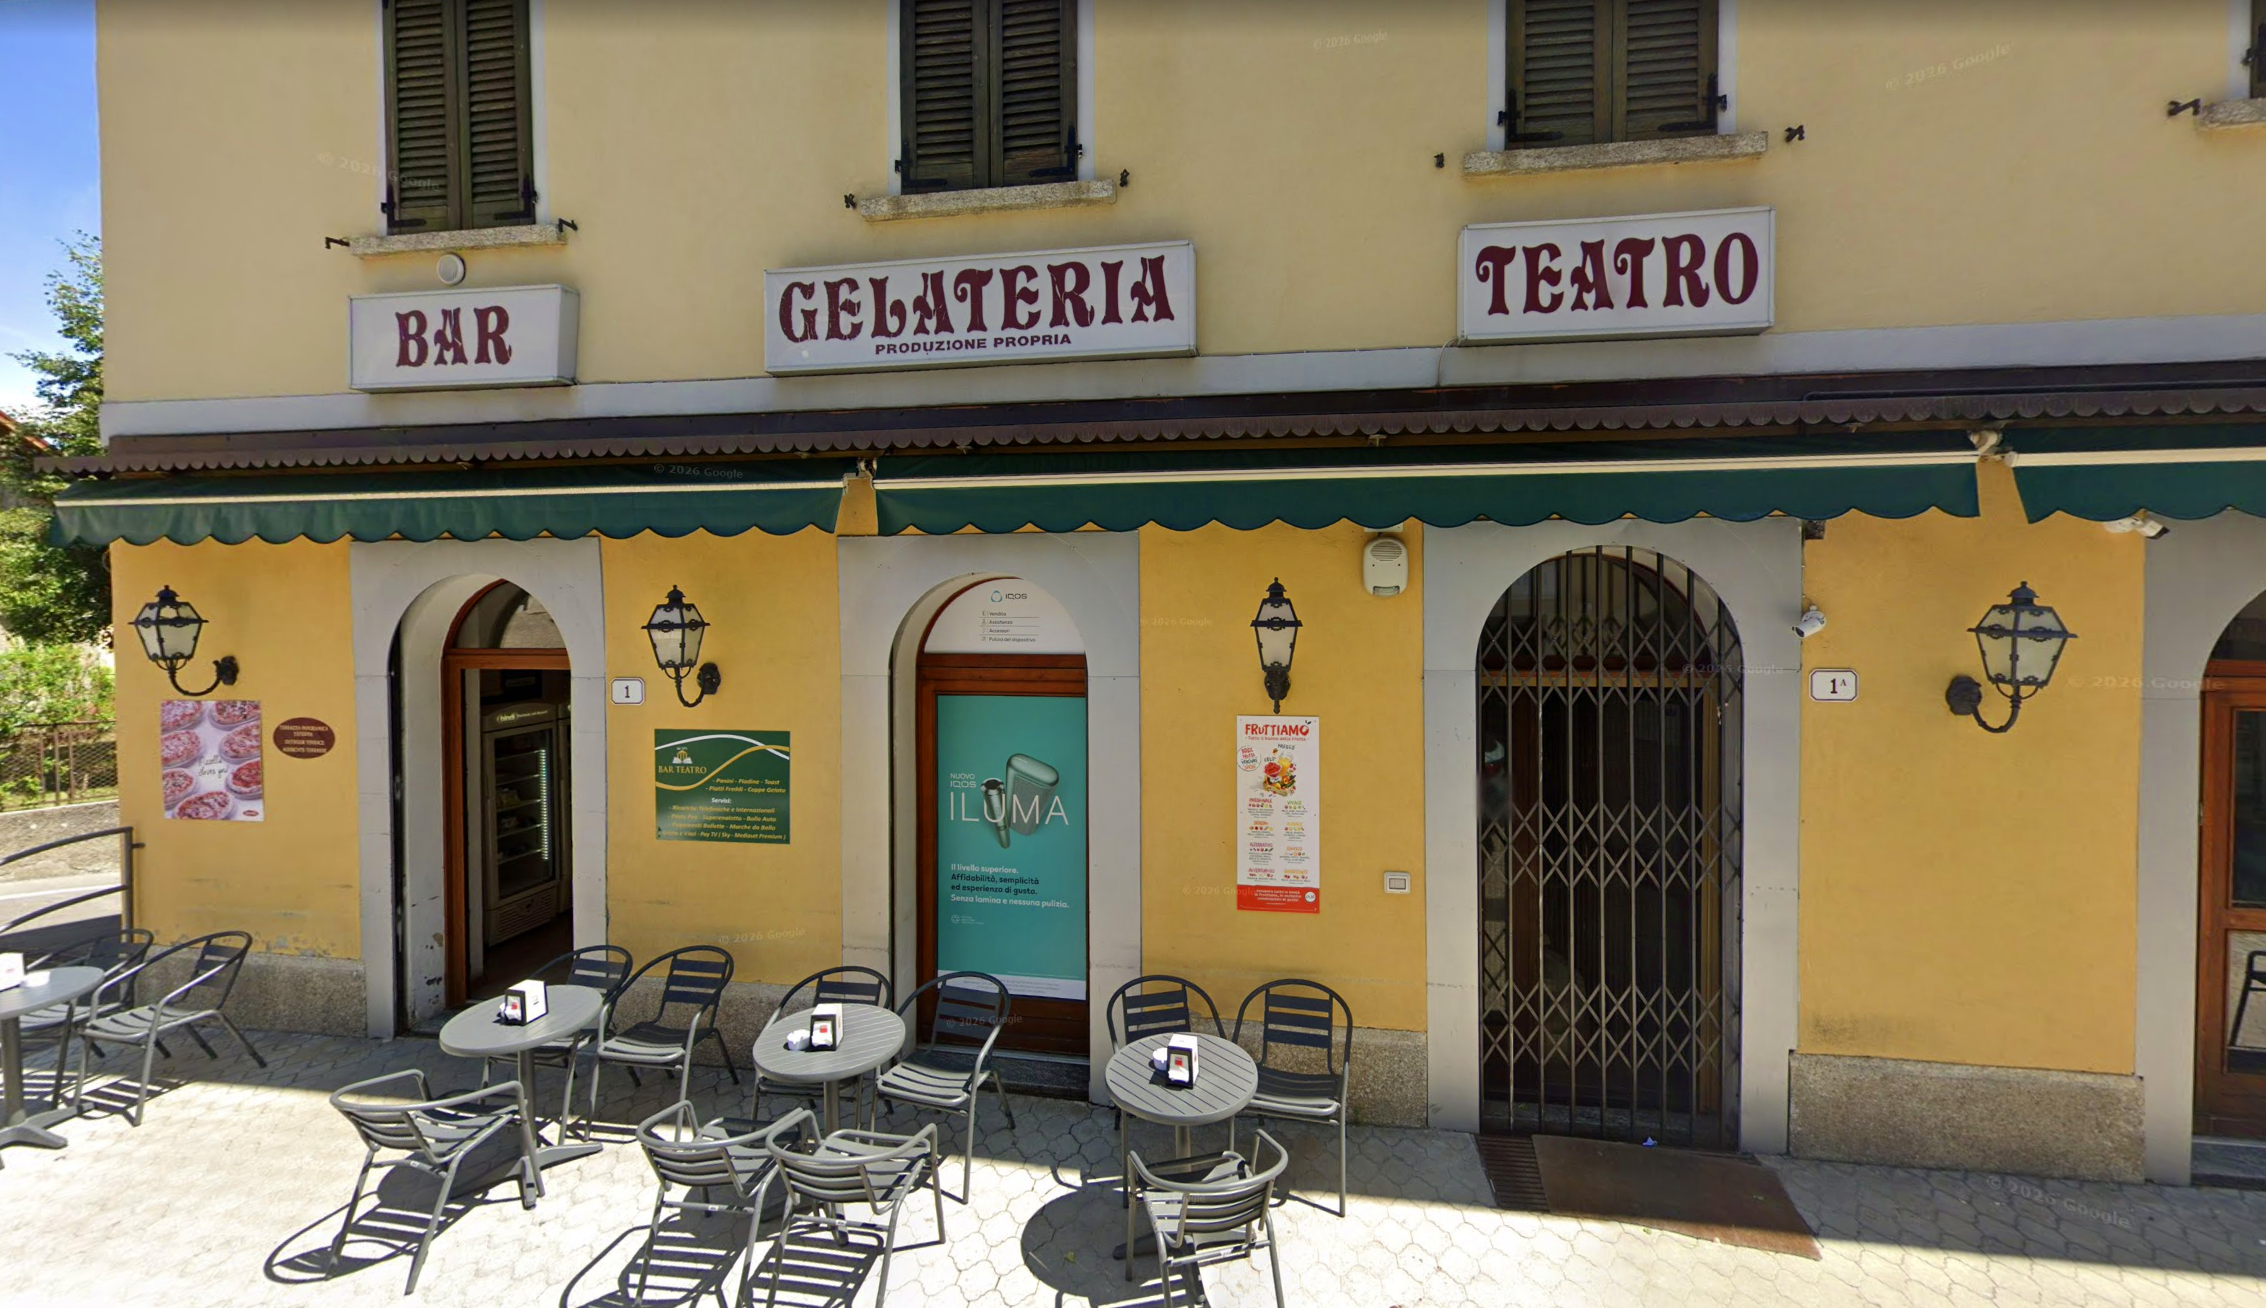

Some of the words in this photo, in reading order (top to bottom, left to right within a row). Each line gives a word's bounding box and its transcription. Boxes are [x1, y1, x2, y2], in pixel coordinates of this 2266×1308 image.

[1475, 230, 1759, 317] TEATRO
[779, 254, 1175, 344] GELATERIA
[395, 304, 513, 368] BAR
[875, 337, 988, 356] PRODUZIONE
[993, 332, 1072, 349] PROPRIA
[624, 685, 631, 699] 1
[658, 765, 674, 774] BAR
[675, 765, 707, 775] TEATRO
[747, 786, 766, 794] Coppe
[950, 780, 977, 789] IQOS
[950, 791, 1069, 826] ILUMA
[702, 814, 742, 822] Superenalotto
[700, 831, 710, 839] Pay
[951, 863, 956, 871] Il
[957, 863, 980, 872] livello
[981, 865, 1019, 875] superiore.
[951, 873, 998, 884] Affidabilità,
[999, 876, 1039, 886] semplicità
[951, 883, 960, 891] ed
[961, 884, 1003, 894] esperienza
[1004, 886, 1012, 894] di
[1013, 888, 1038, 896] gusto.
[951, 894, 974, 902] Senza
[975, 896, 1001, 904] lamina
[1041, 900, 1070, 909] pulizia.
